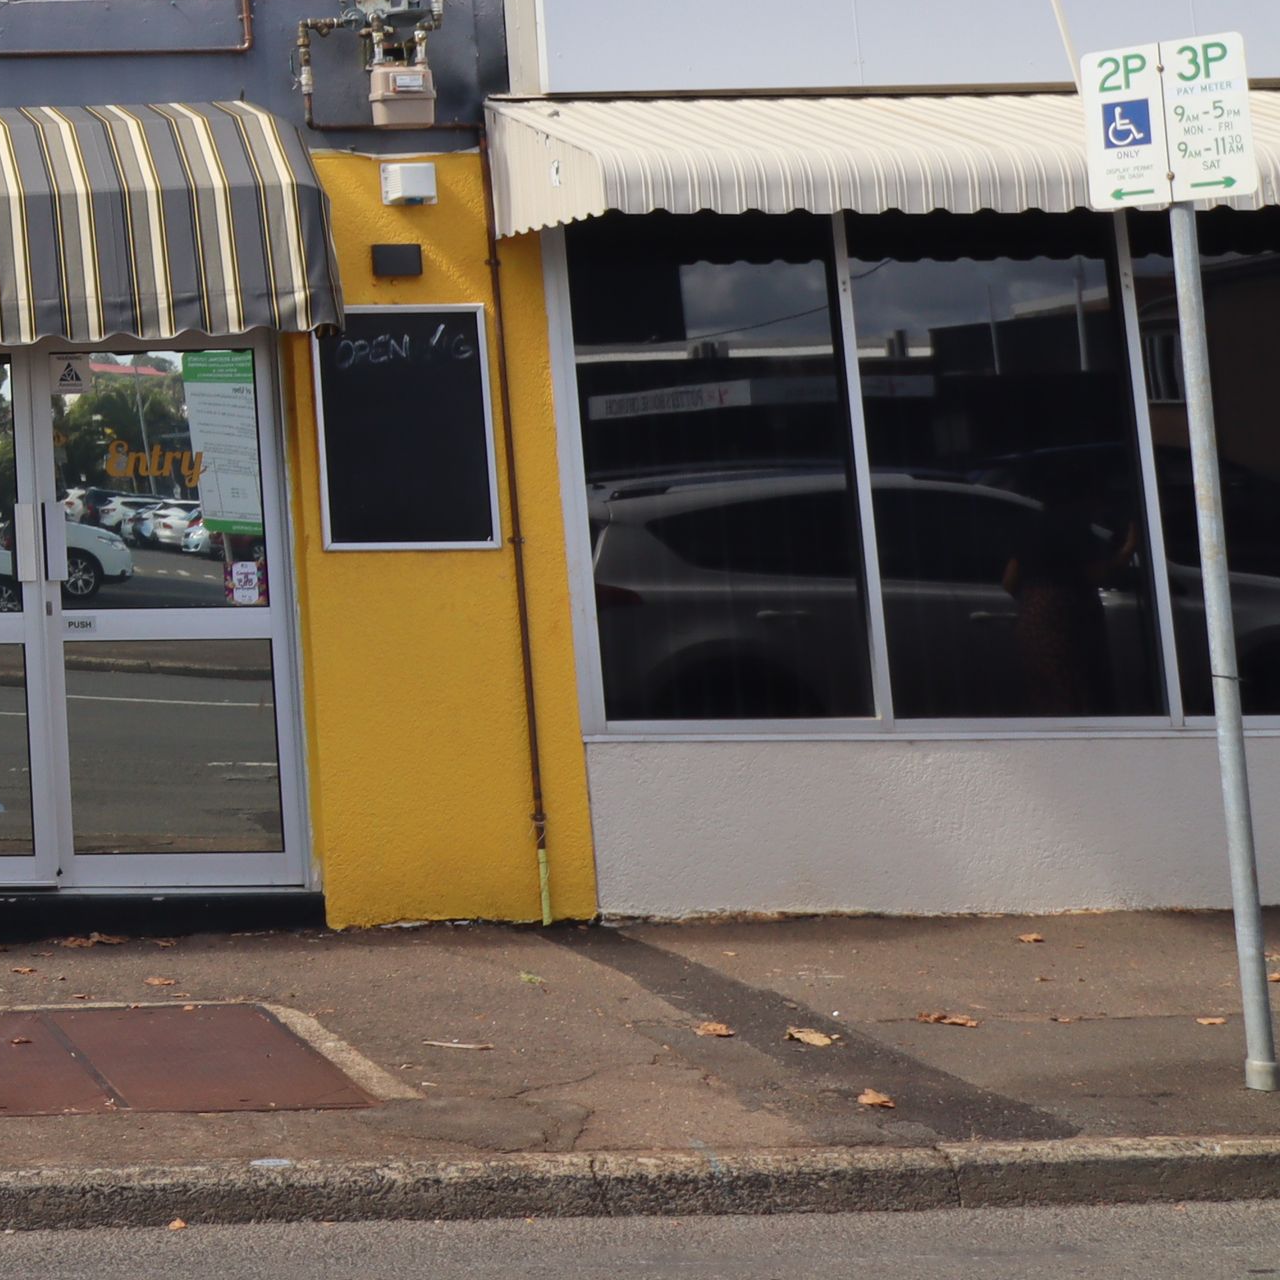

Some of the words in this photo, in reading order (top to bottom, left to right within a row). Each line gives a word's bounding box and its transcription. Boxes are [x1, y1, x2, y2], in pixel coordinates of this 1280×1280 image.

[1176, 42, 1228, 82] 3P
[1097, 53, 1146, 93] 2P
[1176, 87, 1194, 96] PAY
[1200, 81, 1232, 92] METER
[1184, 125, 1203, 136] MON
[1218, 121, 1233, 131] FRI
[1116, 150, 1140, 160] ONLY
[1202, 159, 1221, 171] SAT
[337, 334, 409, 369] OPEN
[106, 441, 208, 488] Entry
[68, 621, 92, 629] PUSH
